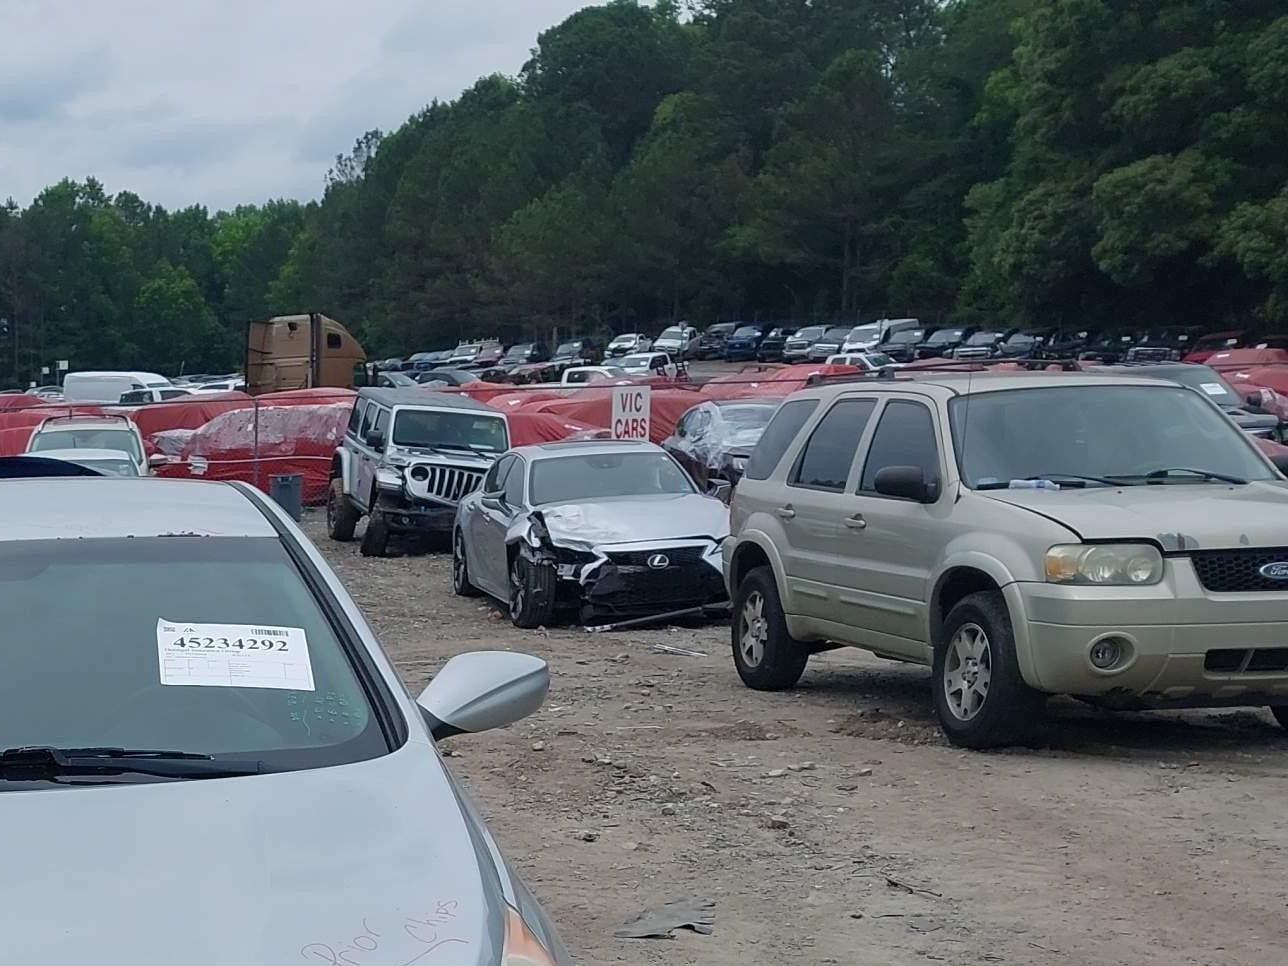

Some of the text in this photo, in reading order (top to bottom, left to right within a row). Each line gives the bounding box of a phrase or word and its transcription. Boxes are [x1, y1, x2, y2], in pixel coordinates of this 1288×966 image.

[620, 392, 642, 412] VIC
[614, 417, 647, 438] CARS
[173, 637, 289, 652] 45234292
